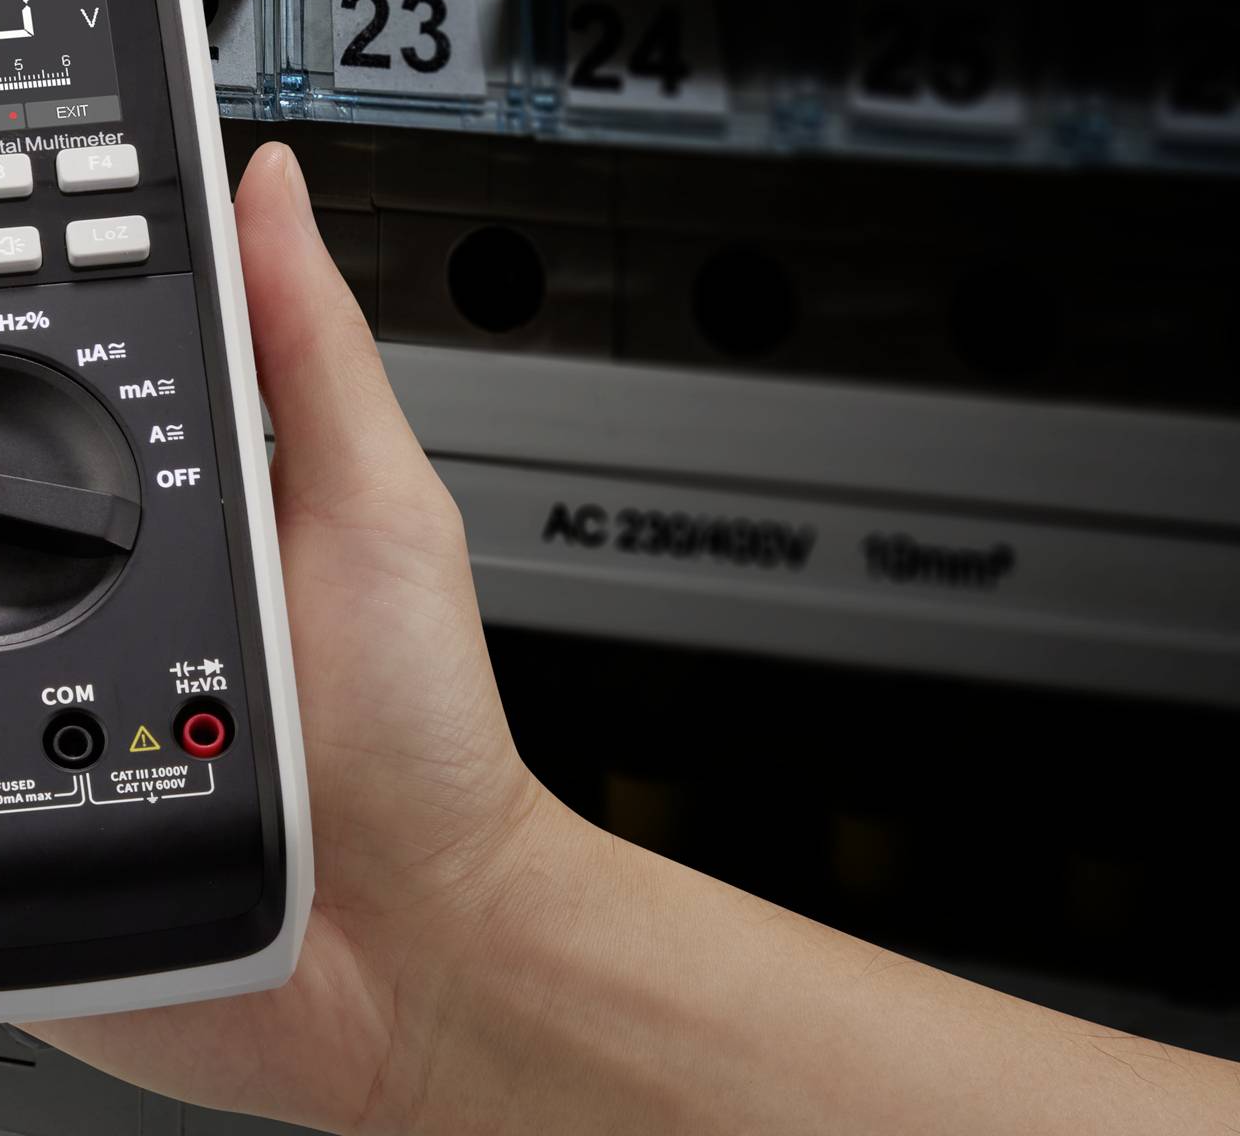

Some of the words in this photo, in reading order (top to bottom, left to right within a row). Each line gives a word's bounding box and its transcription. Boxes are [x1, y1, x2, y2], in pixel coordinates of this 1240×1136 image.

[80, 7, 100, 29] V
[568, 2, 688, 94] 24
[14, 58, 24, 71] 5
[61, 54, 71, 67] 6
[56, 104, 89, 119] EXIT
[26, 130, 125, 152] Multimeter
[88, 155, 113, 171] F4
[92, 226, 130, 242] LoZ
[156, 467, 201, 488] OFF
[541, 501, 609, 549] AC
[175, 675, 228, 694] HzVΩ
[41, 684, 96, 706] COM
[110, 769, 135, 782] CAT
[136, 768, 150, 781] III
[151, 765, 189, 779] 1000V
[116, 781, 141, 794] CAT
[141, 780, 154, 792] IV
[155, 778, 187, 791] 600V
[26, 792, 53, 803] max
